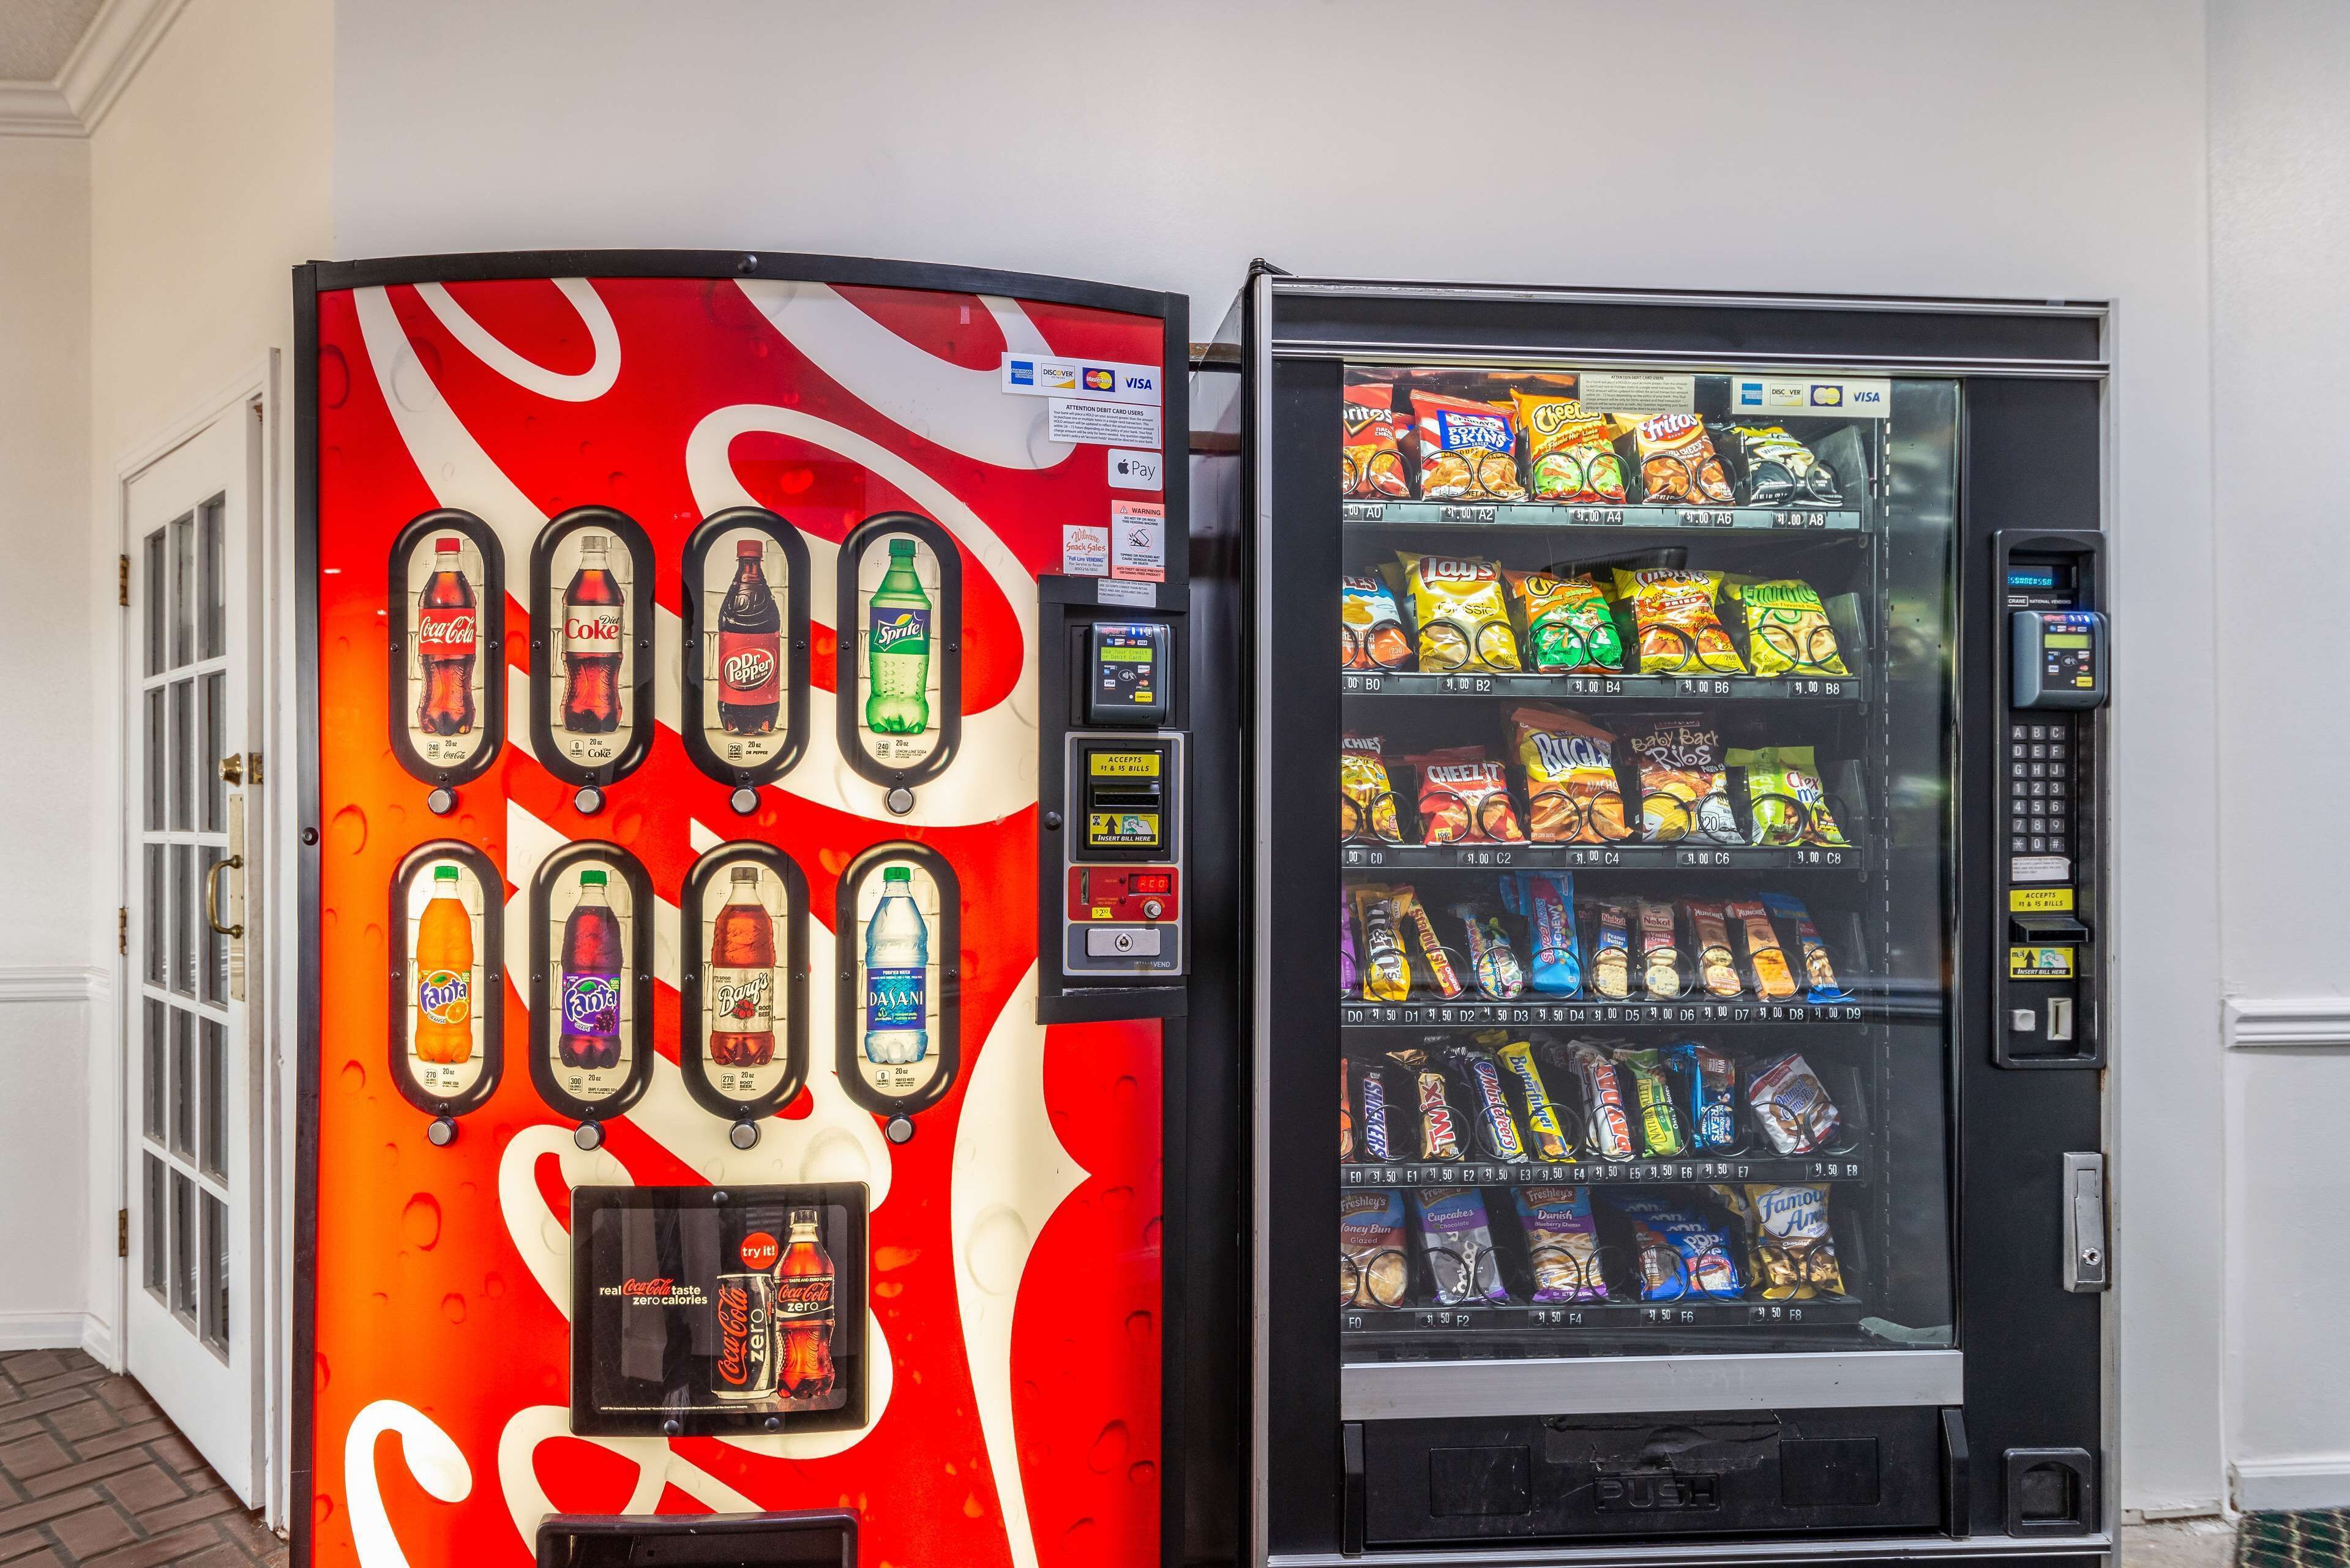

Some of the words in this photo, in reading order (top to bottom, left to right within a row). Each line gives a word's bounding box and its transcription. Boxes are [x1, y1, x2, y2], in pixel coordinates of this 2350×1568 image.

[1124, 377, 1152, 390] VISA
[1854, 392, 1880, 403] VISA
[1450, 433, 1506, 447] SKINS
[1132, 461, 1156, 481] Pay
[1366, 507, 1381, 518] A0
[1478, 508, 1494, 520] A2
[1606, 509, 1622, 523] A4
[1809, 516, 1824, 526] A8
[1072, 529, 1100, 543] Wilmore
[1066, 542, 1086, 552] Snack
[1087, 543, 1106, 553] Sales
[1664, 596, 1697, 608] FRIES
[599, 614, 619, 625] Diet
[420, 615, 476, 644] Coca-Cola
[565, 618, 619, 640] Coke
[879, 621, 921, 644] Sprite
[741, 654, 761, 667] Dr
[725, 657, 772, 683] Pepper
[1476, 680, 1490, 692] B2
[1715, 682, 1729, 693] B6
[1825, 684, 1839, 695] B8
[1631, 731, 1672, 753] Baby
[1680, 728, 1718, 747] Back
[444, 750, 465, 760] Coca-Cola
[1645, 744, 1713, 771] Ribs
[1585, 780, 1618, 792] NACHO
[1371, 853, 1382, 864] C0
[1497, 853, 1511, 864] C2
[1715, 852, 1729, 864] C6
[1827, 852, 1841, 864] C8
[1601, 913, 1625, 925] Nekot
[1694, 909, 1724, 920] MUNCHIES
[1547, 905, 1562, 941] CHEWY
[1644, 917, 1671, 927] Nekot
[1445, 967, 1461, 991] Original
[420, 980, 468, 1012] Fanta
[718, 972, 769, 1018] Barq's
[870, 988, 923, 1011] DASANI
[565, 986, 616, 1021] Fanta
[427, 1014, 446, 1024] ORANGE
[1348, 1010, 1363, 1023] D0
[1570, 1010, 1584, 1021] D4
[1790, 1009, 1803, 1020] D8
[575, 1023, 590, 1032] GRAPE
[1775, 1077, 1806, 1105] Oatmeal
[1802, 1087, 1814, 1101] Pie
[1363, 1078, 1388, 1159] SNICKERS
[1423, 1082, 1456, 1152] TWIX
[1645, 1110, 1663, 1140] NATURE
[1574, 1170, 1585, 1179] E4
[1847, 1165, 1857, 1176] E8
[1350, 1172, 1361, 1182] E0
[1529, 1189, 1573, 1203] Freshley's
[1341, 1197, 1386, 1212] Freshley's
[1428, 1209, 1474, 1223] Cupcakes
[1538, 1210, 1572, 1220] Danish
[1370, 1224, 1391, 1233] Bun
[742, 1246, 761, 1258] try
[763, 1245, 775, 1256] it!
[600, 1286, 621, 1295] real
[623, 1278, 673, 1295] Coca-Cola
[672, 1286, 700, 1295] taste
[778, 1283, 830, 1302] Coca-Cola
[633, 1296, 660, 1305] zero
[662, 1294, 708, 1305] calories
[788, 1301, 818, 1312] zero
[1681, 1312, 1693, 1323] F6
[1789, 1309, 1802, 1320] F8
[1349, 1317, 1361, 1329] F0
[1457, 1315, 1469, 1327] F2
[717, 1284, 748, 1384] Coca-Cola
[751, 1308, 765, 1362] zero
